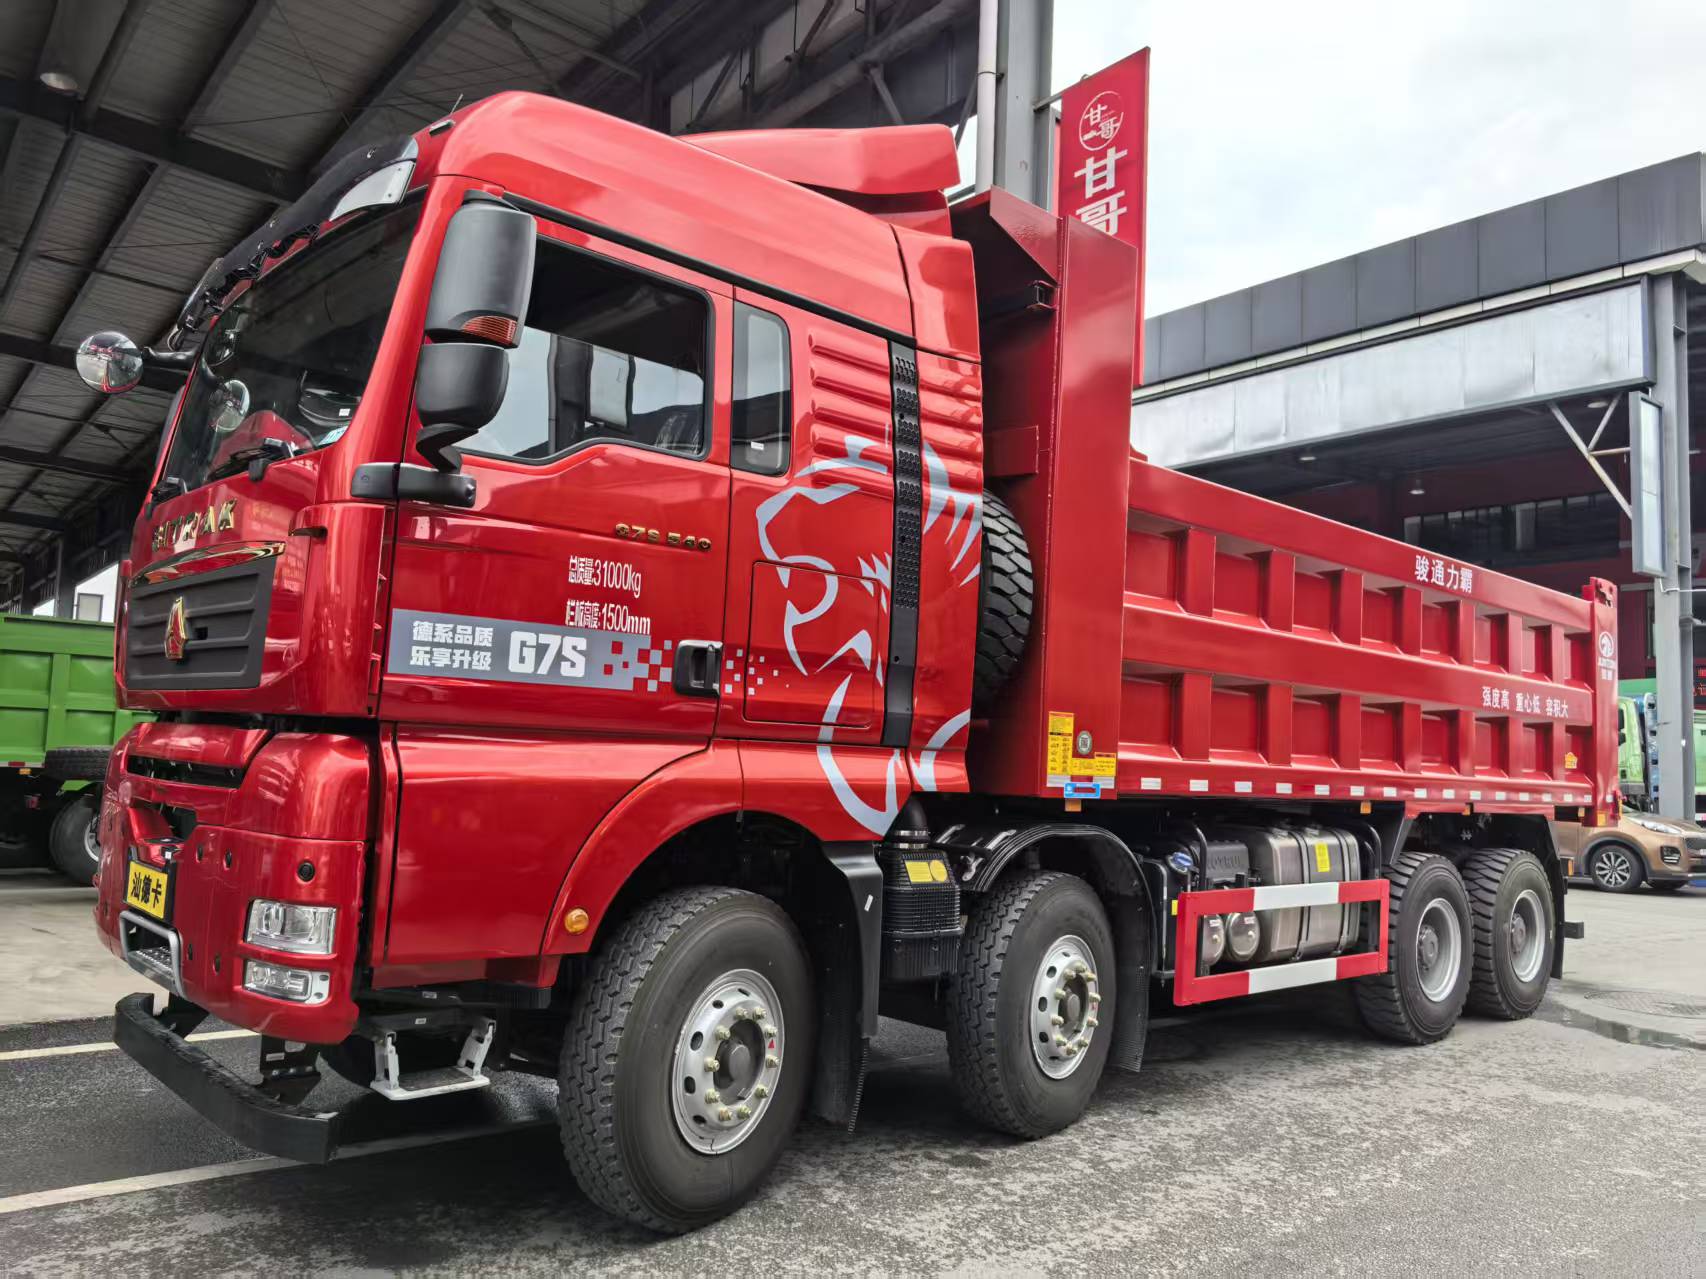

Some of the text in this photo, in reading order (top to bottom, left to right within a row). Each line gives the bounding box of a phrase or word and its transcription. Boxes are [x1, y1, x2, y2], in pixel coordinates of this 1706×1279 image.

[1073, 146, 1128, 236] 甘哥
[152, 498, 237, 551] SITRAK
[616, 523, 711, 550] G7S 540
[1414, 554, 1473, 594] 骏通力霸
[412, 620, 494, 647] 德系品质
[409, 645, 492, 671] 乐享升级
[508, 630, 587, 677] G7S
[1482, 686, 1569, 718] 强度高 重心低 容积大
[131, 872, 162, 909] 汕德卡
